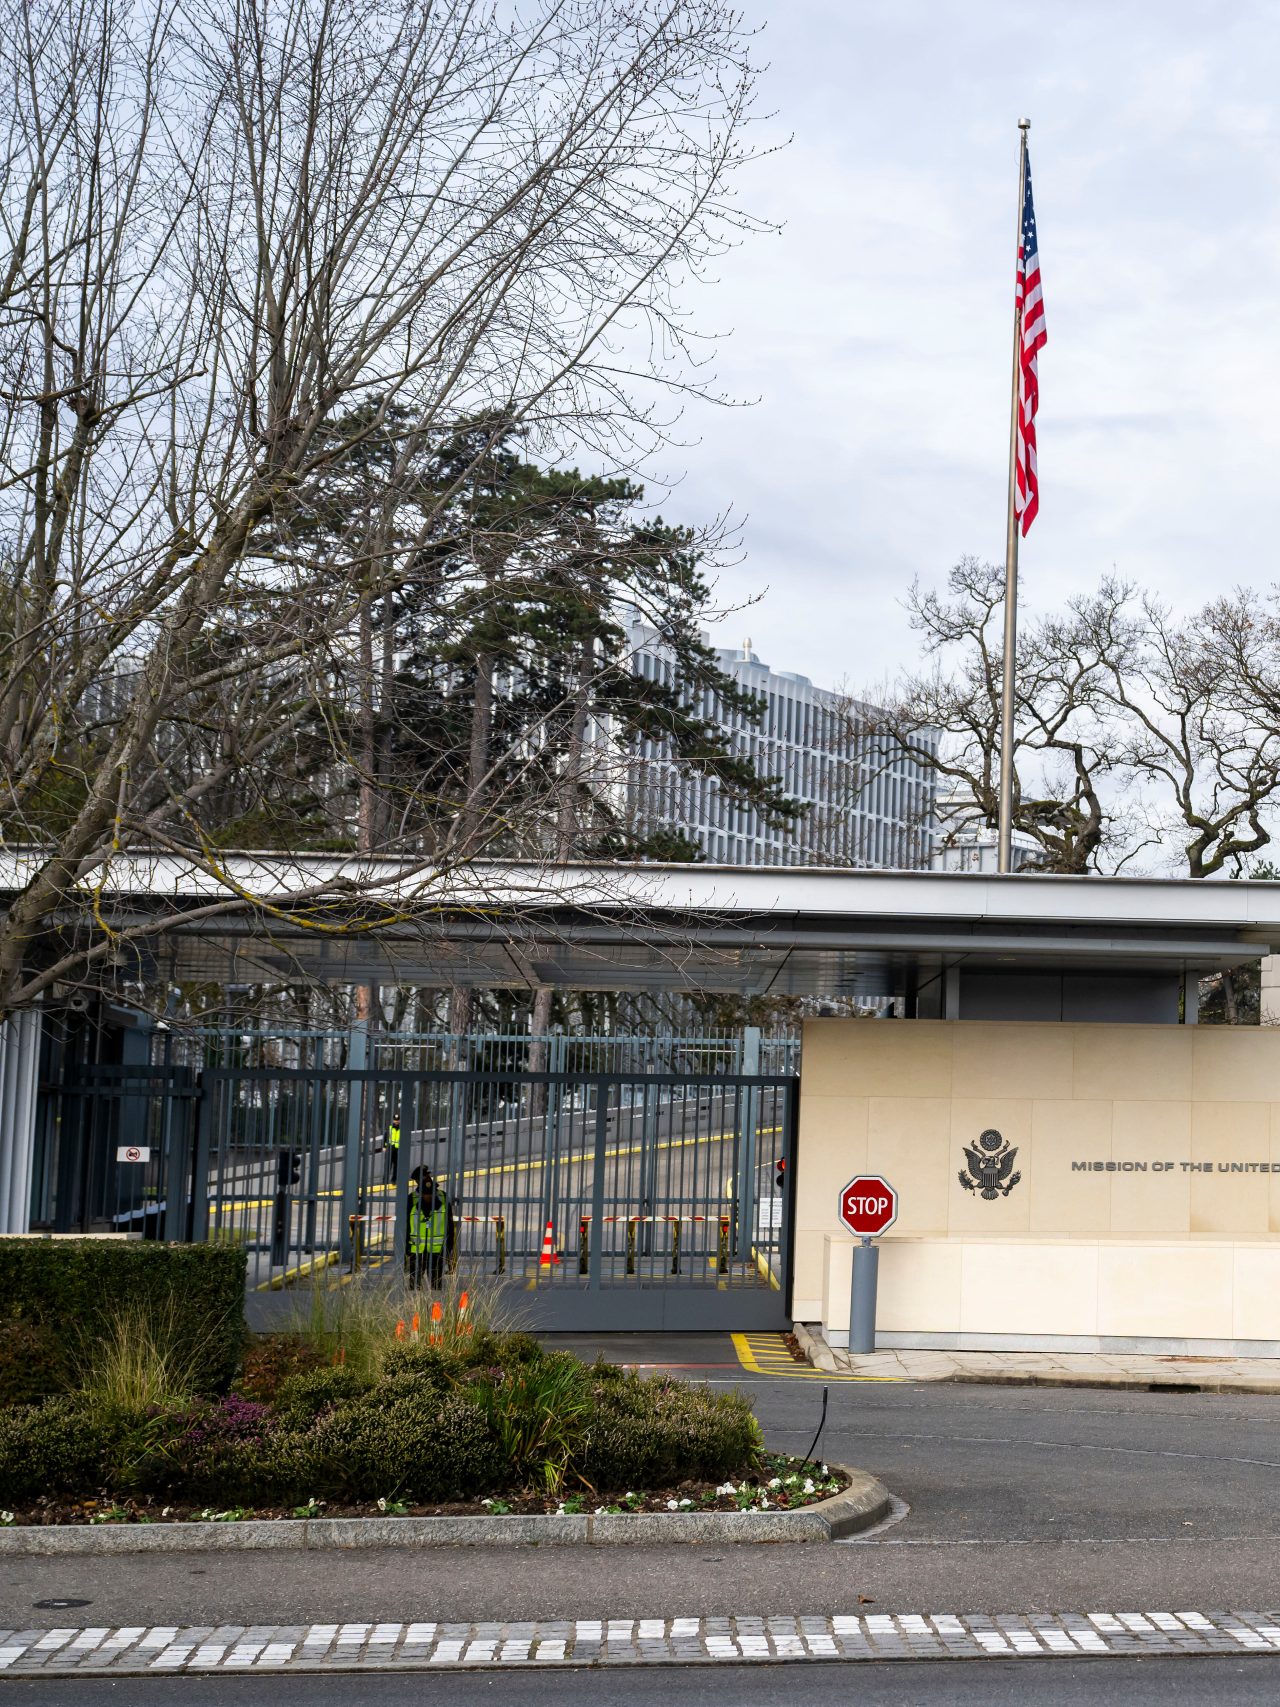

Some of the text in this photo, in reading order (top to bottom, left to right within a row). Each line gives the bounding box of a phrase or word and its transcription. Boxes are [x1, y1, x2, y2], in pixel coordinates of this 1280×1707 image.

[1071, 1161, 1147, 1172] MISSION
[1151, 1161, 1174, 1172] OF
[1180, 1162, 1213, 1173] THE
[847, 1196, 888, 1215] STOP
